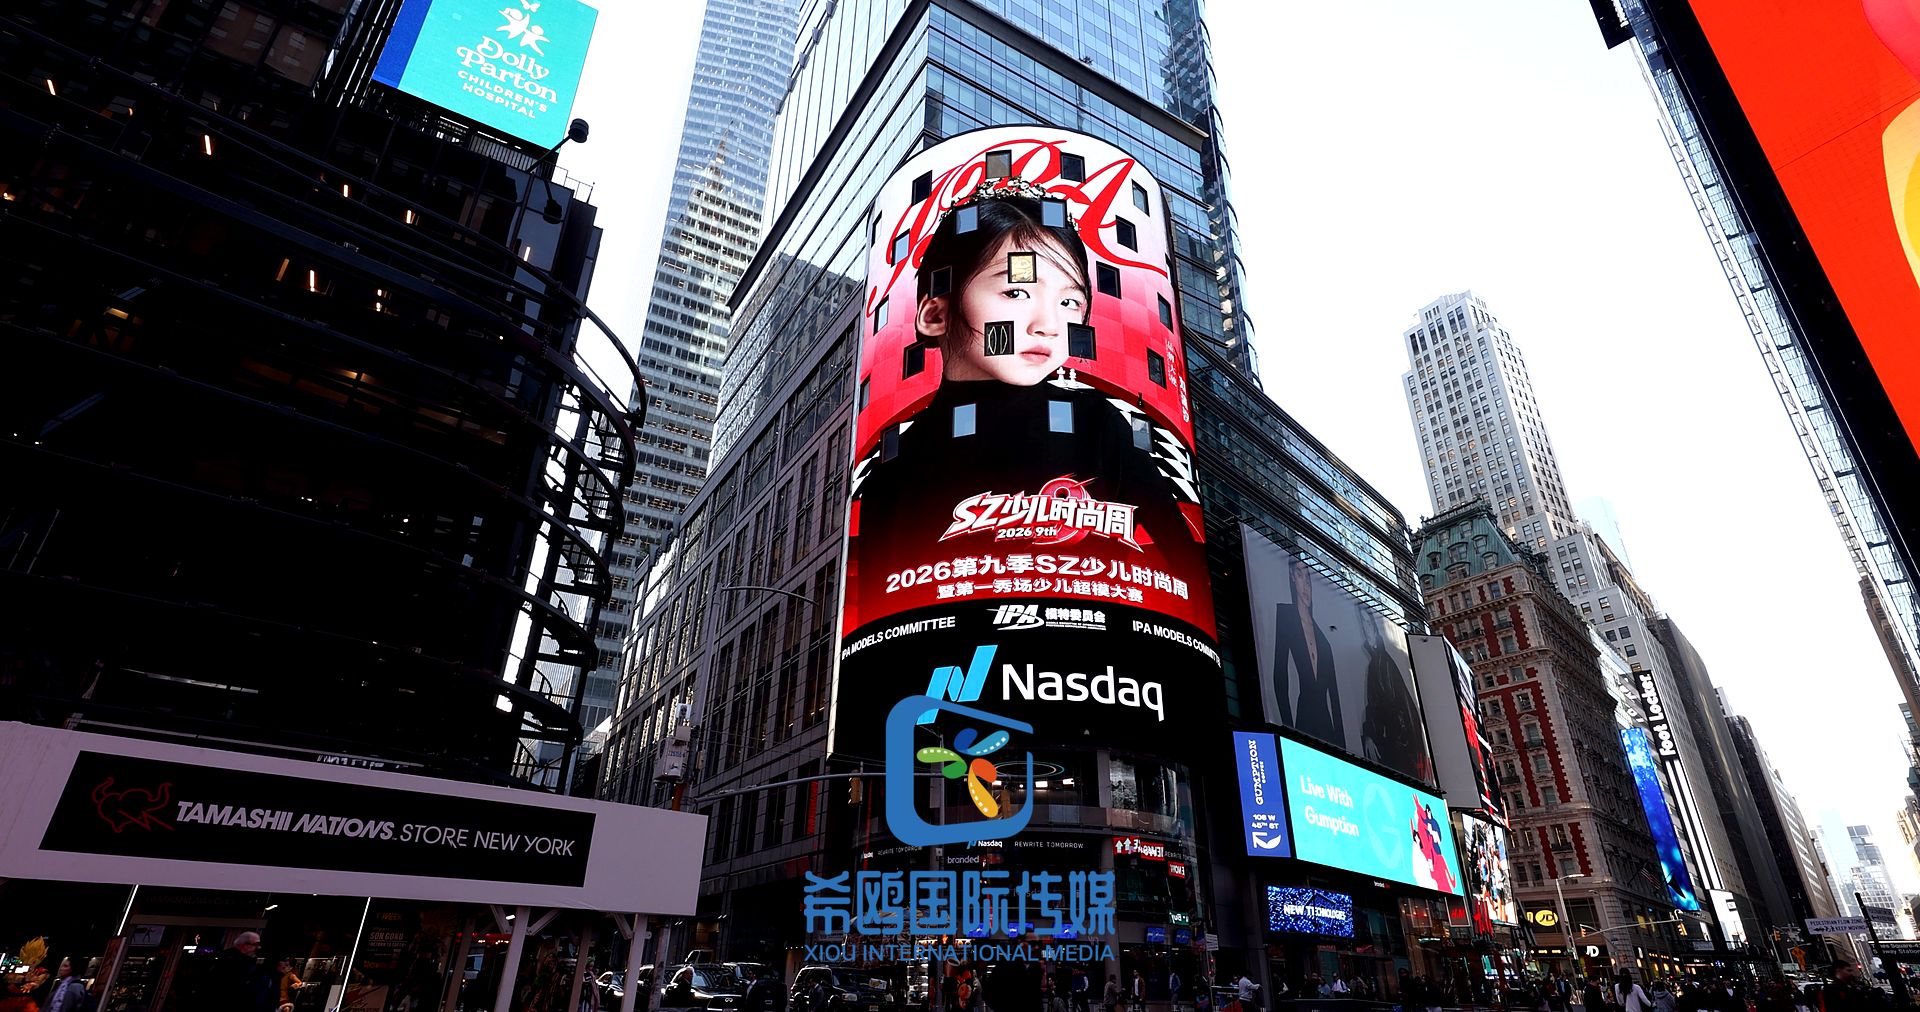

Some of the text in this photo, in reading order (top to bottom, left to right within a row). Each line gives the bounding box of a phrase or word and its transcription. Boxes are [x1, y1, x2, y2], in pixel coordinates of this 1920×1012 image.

[457, 46, 558, 103] Parton
[476, 36, 549, 80] Dolly
[457, 70, 548, 112] CHILDREN'S
[463, 83, 536, 118] HOSPITAL
[947, 493, 1133, 540] SZ少儿时尚周
[997, 527, 1057, 539] 2026 9th
[886, 553, 1189, 600] 2026第九季SZ少儿时尚周
[936, 577, 1144, 603] 暨第一秀场少儿超模大赛
[990, 604, 1042, 628] IPA
[1132, 620, 1152, 635] IPA
[1153, 625, 1192, 647] MODELS
[851, 632, 883, 654] MODELS
[885, 616, 956, 640] COMMITTEE
[1002, 663, 1165, 722] Nasdaq
[1639, 673, 1677, 757] Foot Locker
[1247, 739, 1264, 806] GUMPTION
[1300, 775, 1354, 809] Live With
[176, 800, 293, 831] TAMASHII
[400, 823, 467, 848] STORE
[473, 830, 521, 852] NEW
[524, 835, 576, 857] YORK
[1305, 805, 1360, 837] Gumption
[947, 855, 980, 864] branded
[977, 840, 1003, 848] Nasdaq
[1046, 841, 1084, 849] TOMORROW
[1283, 904, 1305, 916] NEW
[1585, 945, 1600, 958] JD
